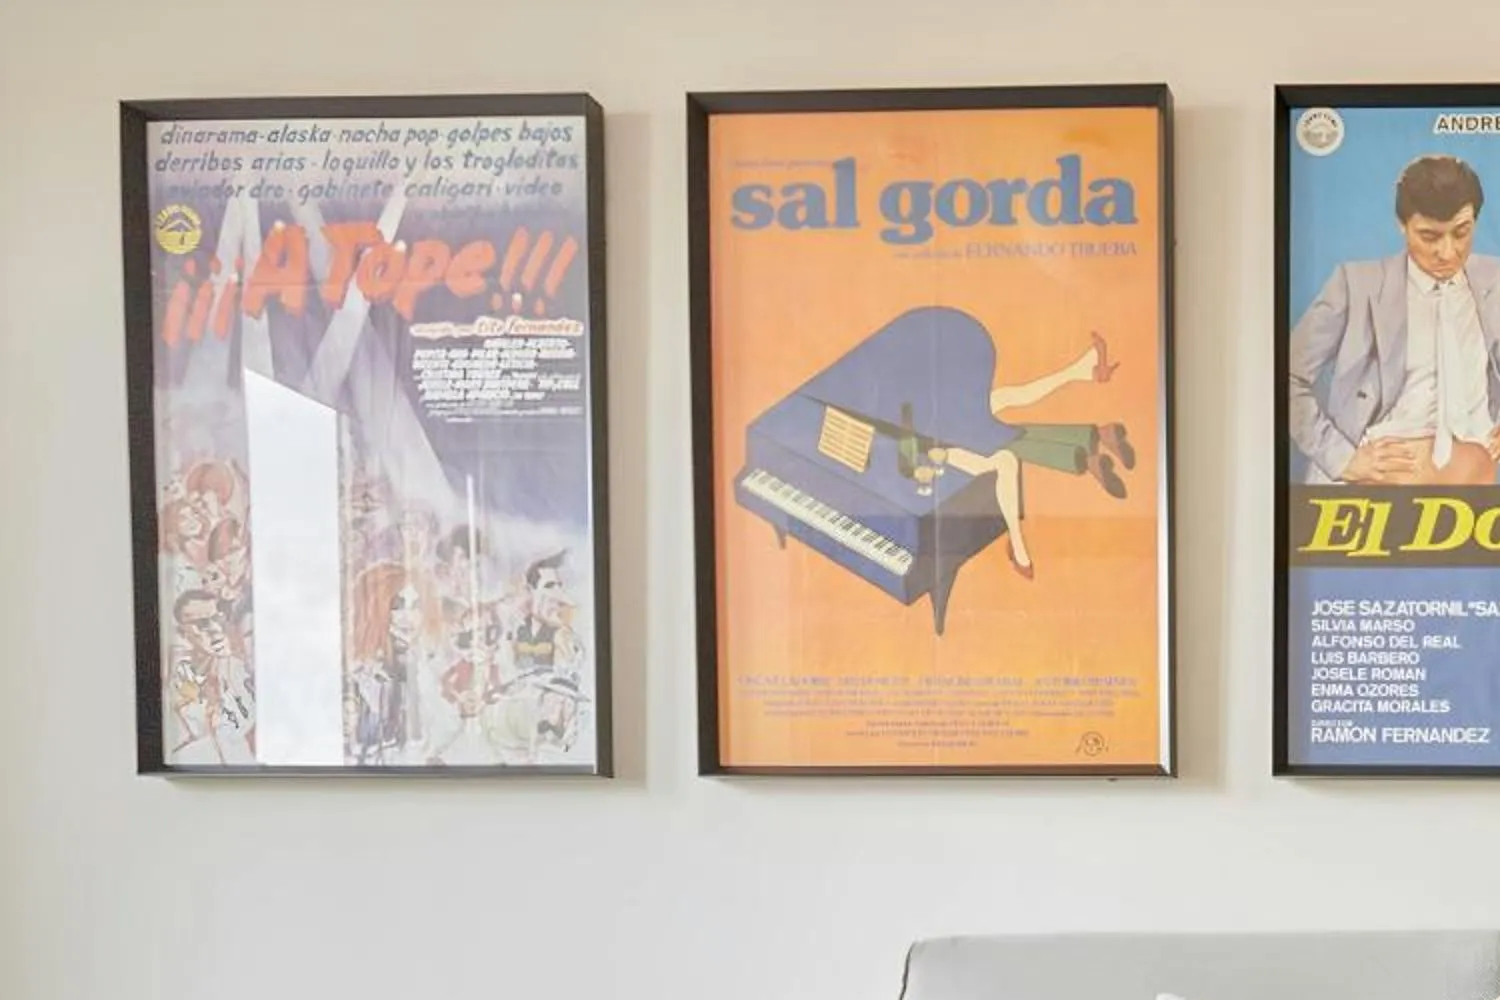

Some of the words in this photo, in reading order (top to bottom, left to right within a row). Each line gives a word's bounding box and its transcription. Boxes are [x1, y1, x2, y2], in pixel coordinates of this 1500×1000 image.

[404, 126, 439, 148] pop
[446, 121, 513, 149] golpes
[518, 120, 573, 147] bajos
[251, 152, 307, 171] arias
[404, 155, 418, 178] y
[424, 149, 454, 170] los
[731, 156, 860, 231] sal
[879, 154, 1138, 245] gorda
[1297, 498, 1392, 557] El
[1311, 600, 1356, 617] JOSE
[1358, 600, 1468, 617] SAZATORNIL
[1311, 619, 1357, 633] SILVIA
[1359, 619, 1415, 633] MARSO
[1311, 635, 1385, 649] ALFONSO
[1388, 635, 1419, 649] DEL
[1423, 635, 1462, 649] REAL
[1311, 651, 1345, 665] LUIS
[1347, 651, 1420, 665] BARBERO
[1311, 667, 1368, 681] JOSELE
[1371, 667, 1426, 681] ROMAN
[1311, 683, 1355, 697] ENMA
[1356, 683, 1420, 697] OZORES
[1311, 699, 1373, 713] GRACITA
[1377, 699, 1451, 713] MORALES
[1381, 727, 1491, 743] FERNANDEZ
